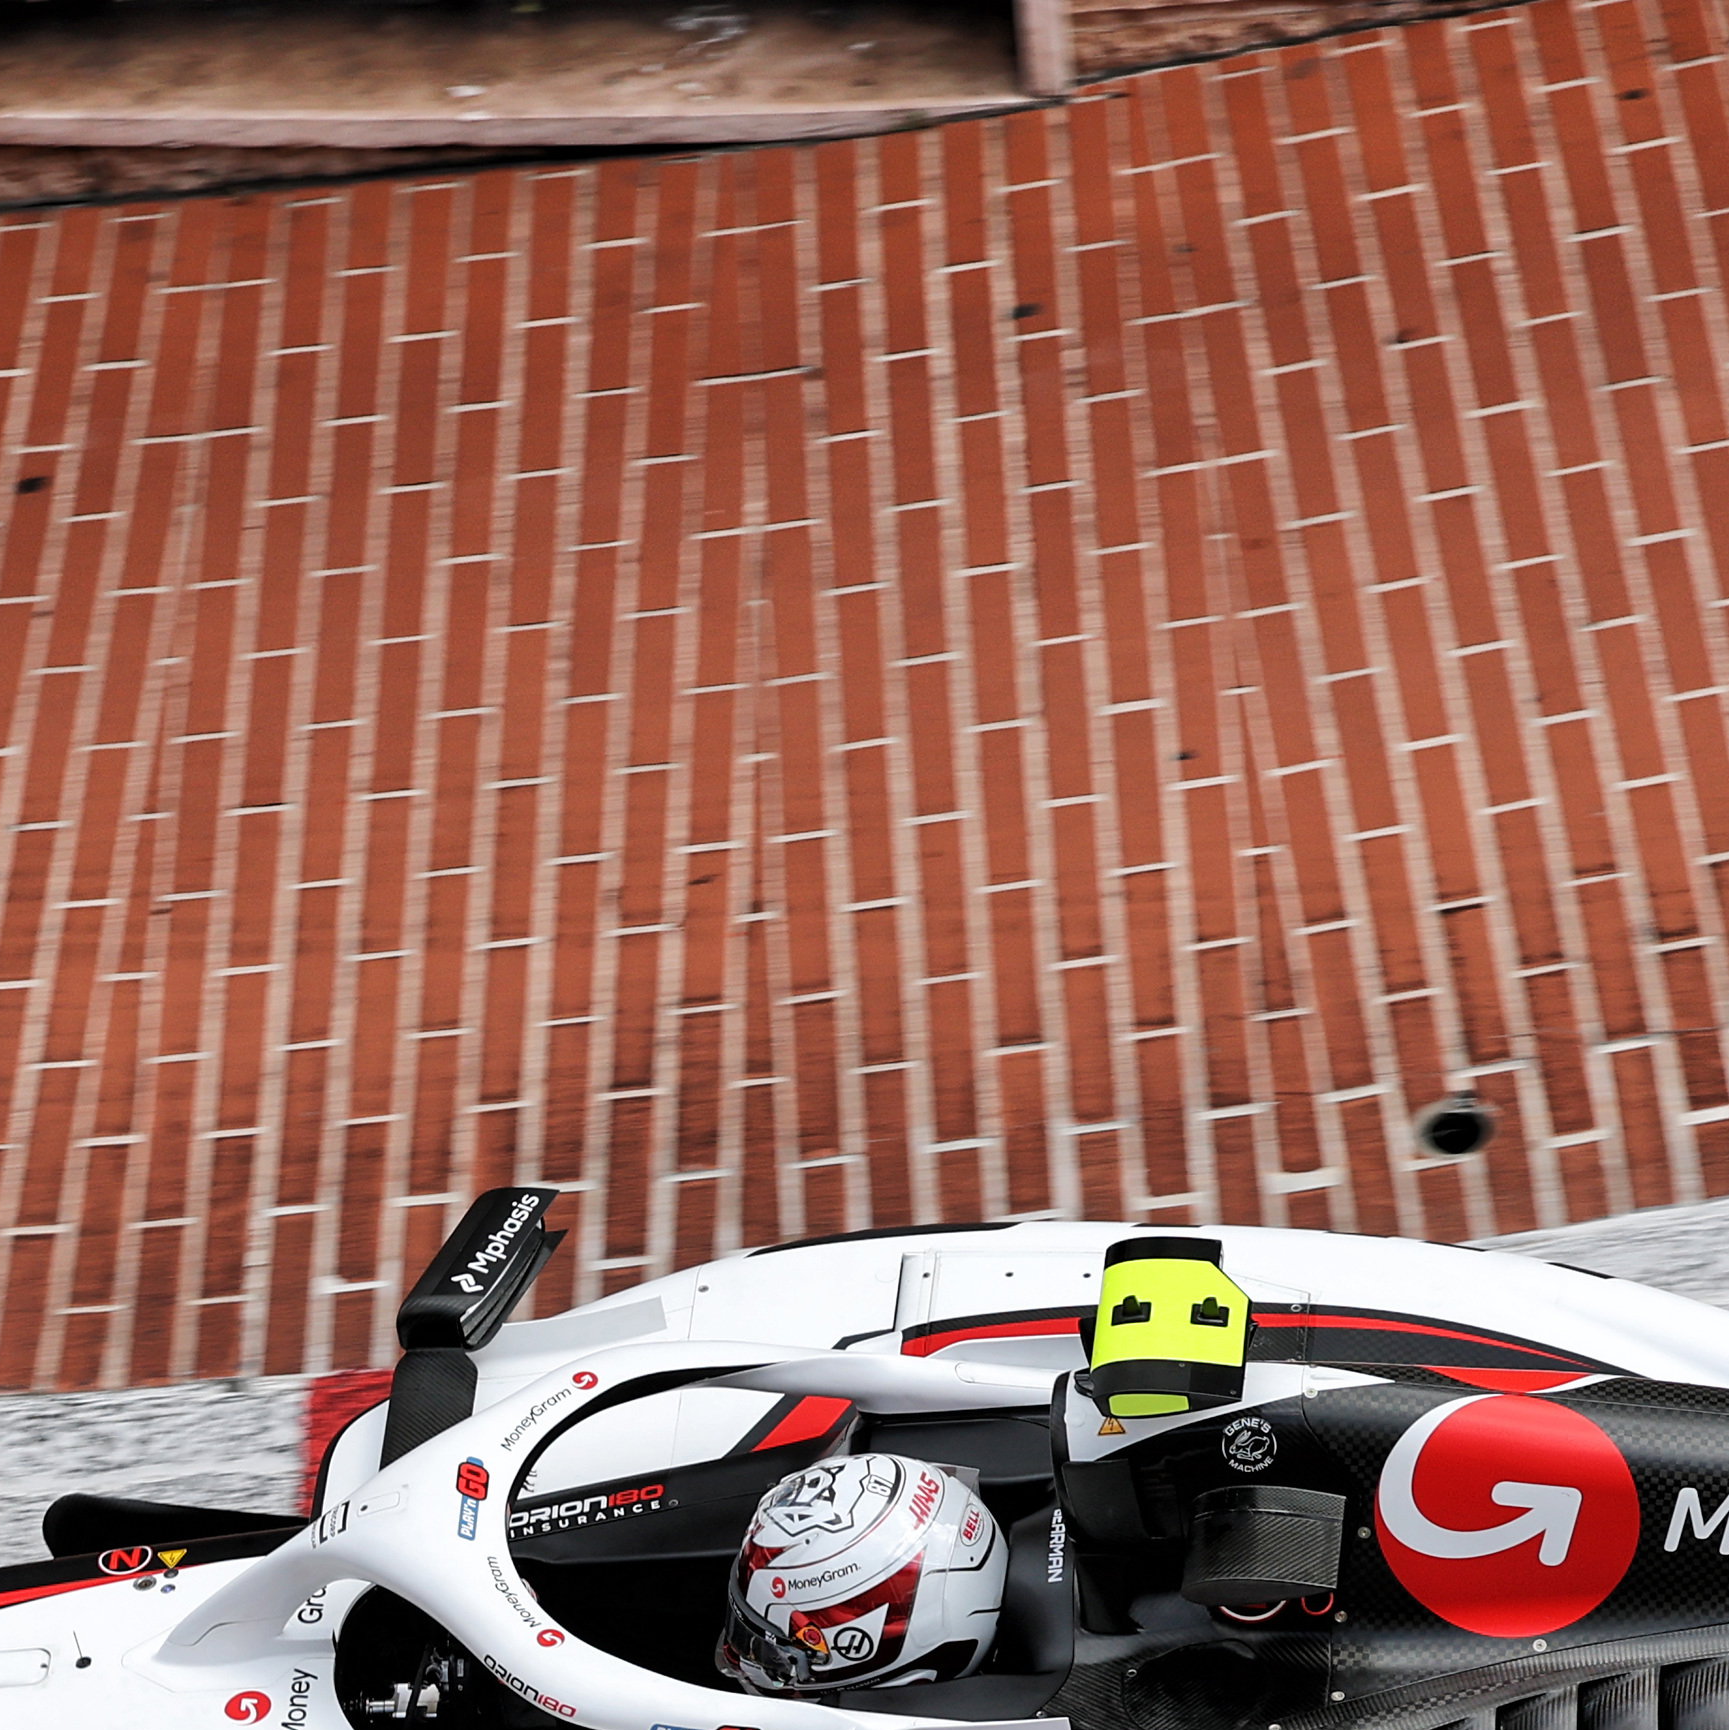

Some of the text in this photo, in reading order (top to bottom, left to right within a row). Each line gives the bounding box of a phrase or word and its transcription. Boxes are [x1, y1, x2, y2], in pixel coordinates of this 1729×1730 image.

[484, 1192, 540, 1278] Mphasis
[500, 1386, 572, 1452] MoneyGram
[1224, 1417, 1272, 1437] GENE'S
[457, 1461, 490, 1501] GO
[1228, 1455, 1274, 1473] MACHINE
[509, 1484, 665, 1528] ORION180
[510, 1500, 661, 1539] INSURANCE
[908, 1471, 941, 1531] HAAS
[962, 1509, 980, 1541] BELL
[487, 1555, 543, 1628] MoneyGram
[483, 1654, 577, 1718] ORION180
